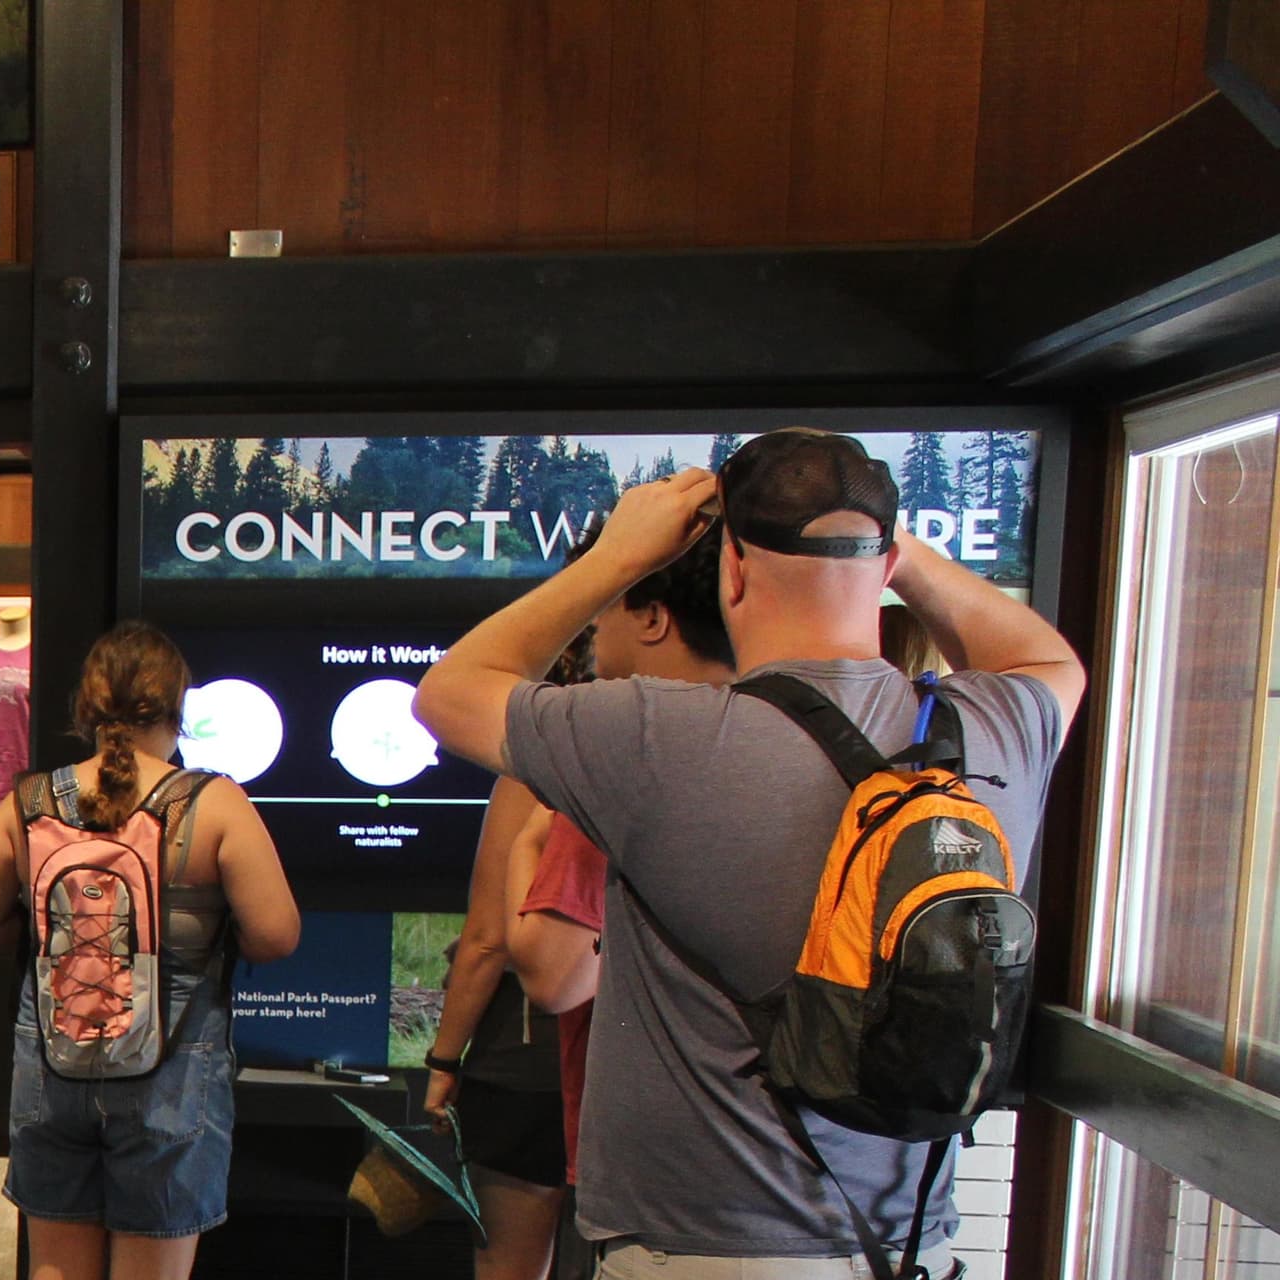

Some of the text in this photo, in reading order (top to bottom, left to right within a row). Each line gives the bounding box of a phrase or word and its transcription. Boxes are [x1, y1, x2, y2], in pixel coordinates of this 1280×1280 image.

[175, 510, 509, 562] CONNECT
[322, 646, 367, 664] How
[372, 645, 386, 664] it
[339, 825, 419, 836] Share with fellow
[355, 837, 402, 847] naturalists
[934, 844, 983, 854] KELTY
[238, 991, 377, 1006] National Parks Passport?
[232, 1006, 326, 1020] your stamp here!
